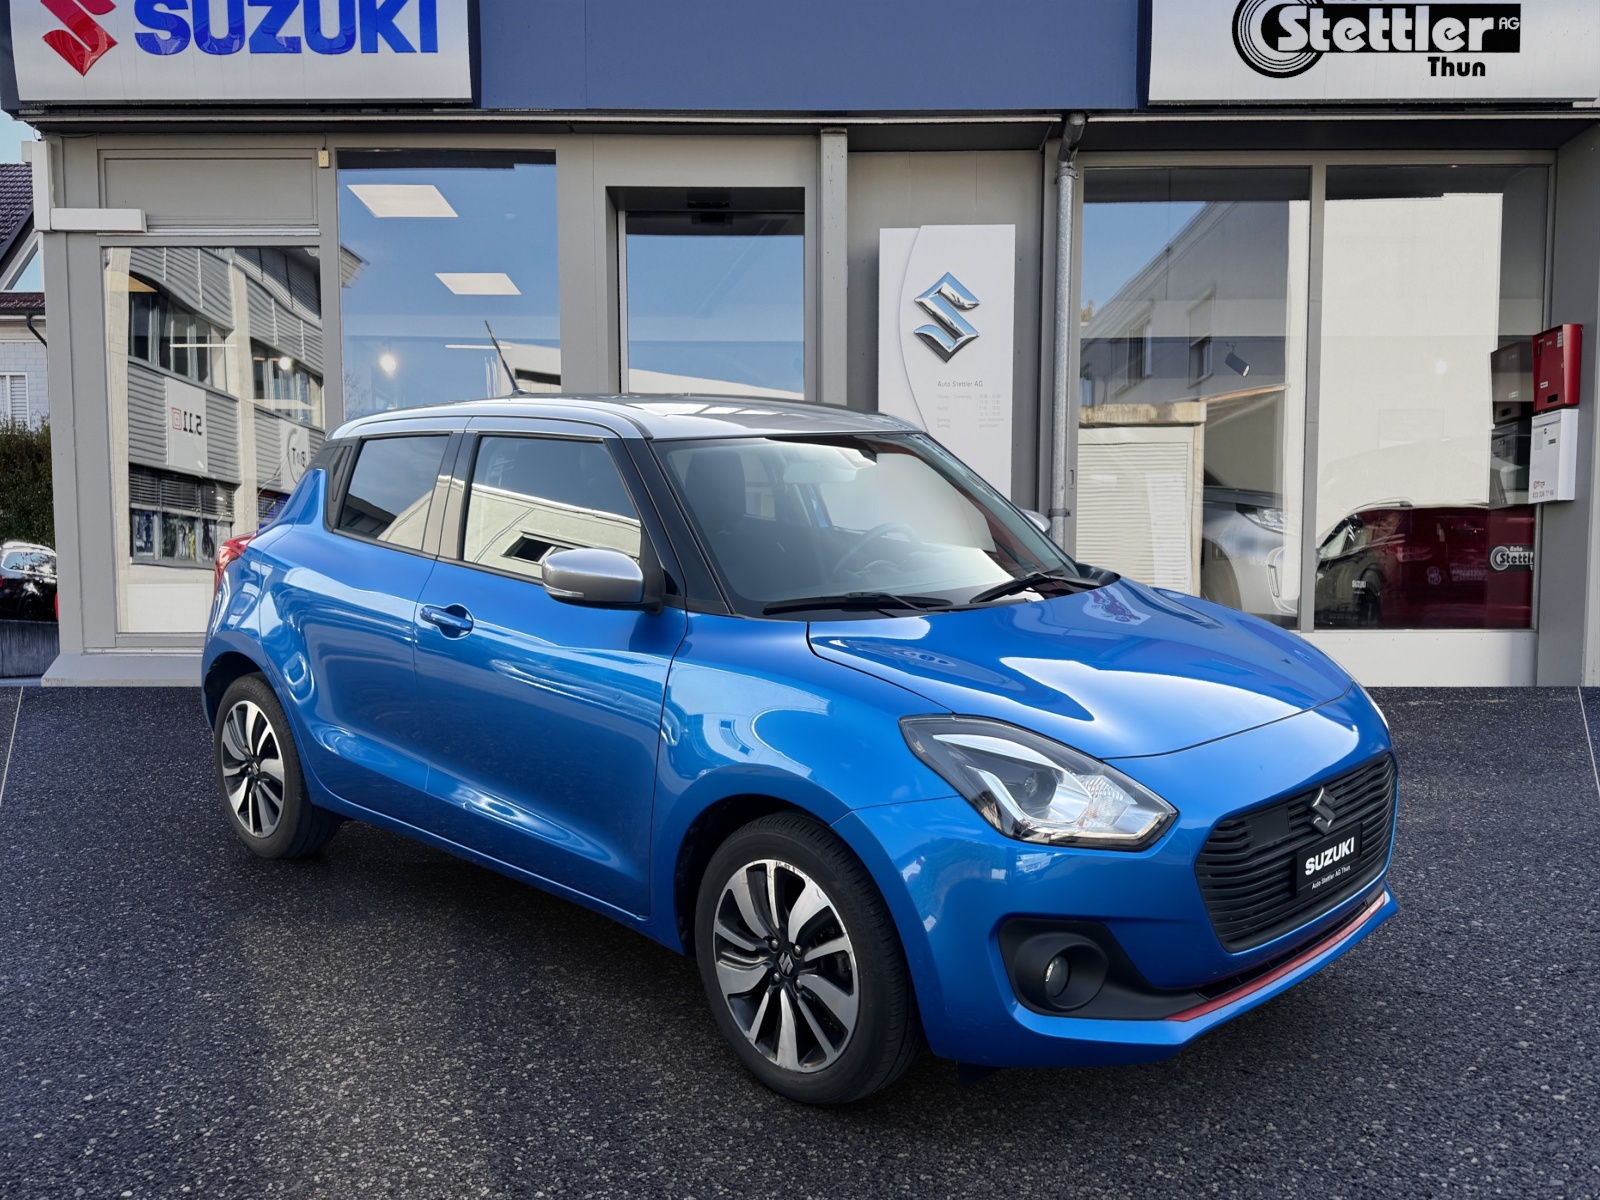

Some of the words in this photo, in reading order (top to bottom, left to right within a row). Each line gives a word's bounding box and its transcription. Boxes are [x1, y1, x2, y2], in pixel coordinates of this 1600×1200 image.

[135, 0, 438, 55] SUZUKI
[1278, 5, 1494, 52] Stettler
[1499, 17, 1519, 30] AG
[1428, 56, 1486, 77] Thun
[1500, 552, 1533, 564] Stettl
[1305, 837, 1355, 876] SUZUKI
[1312, 880, 1321, 890] Auto
[1335, 868, 1341, 877] AG
[1341, 865, 1351, 874] Thun
